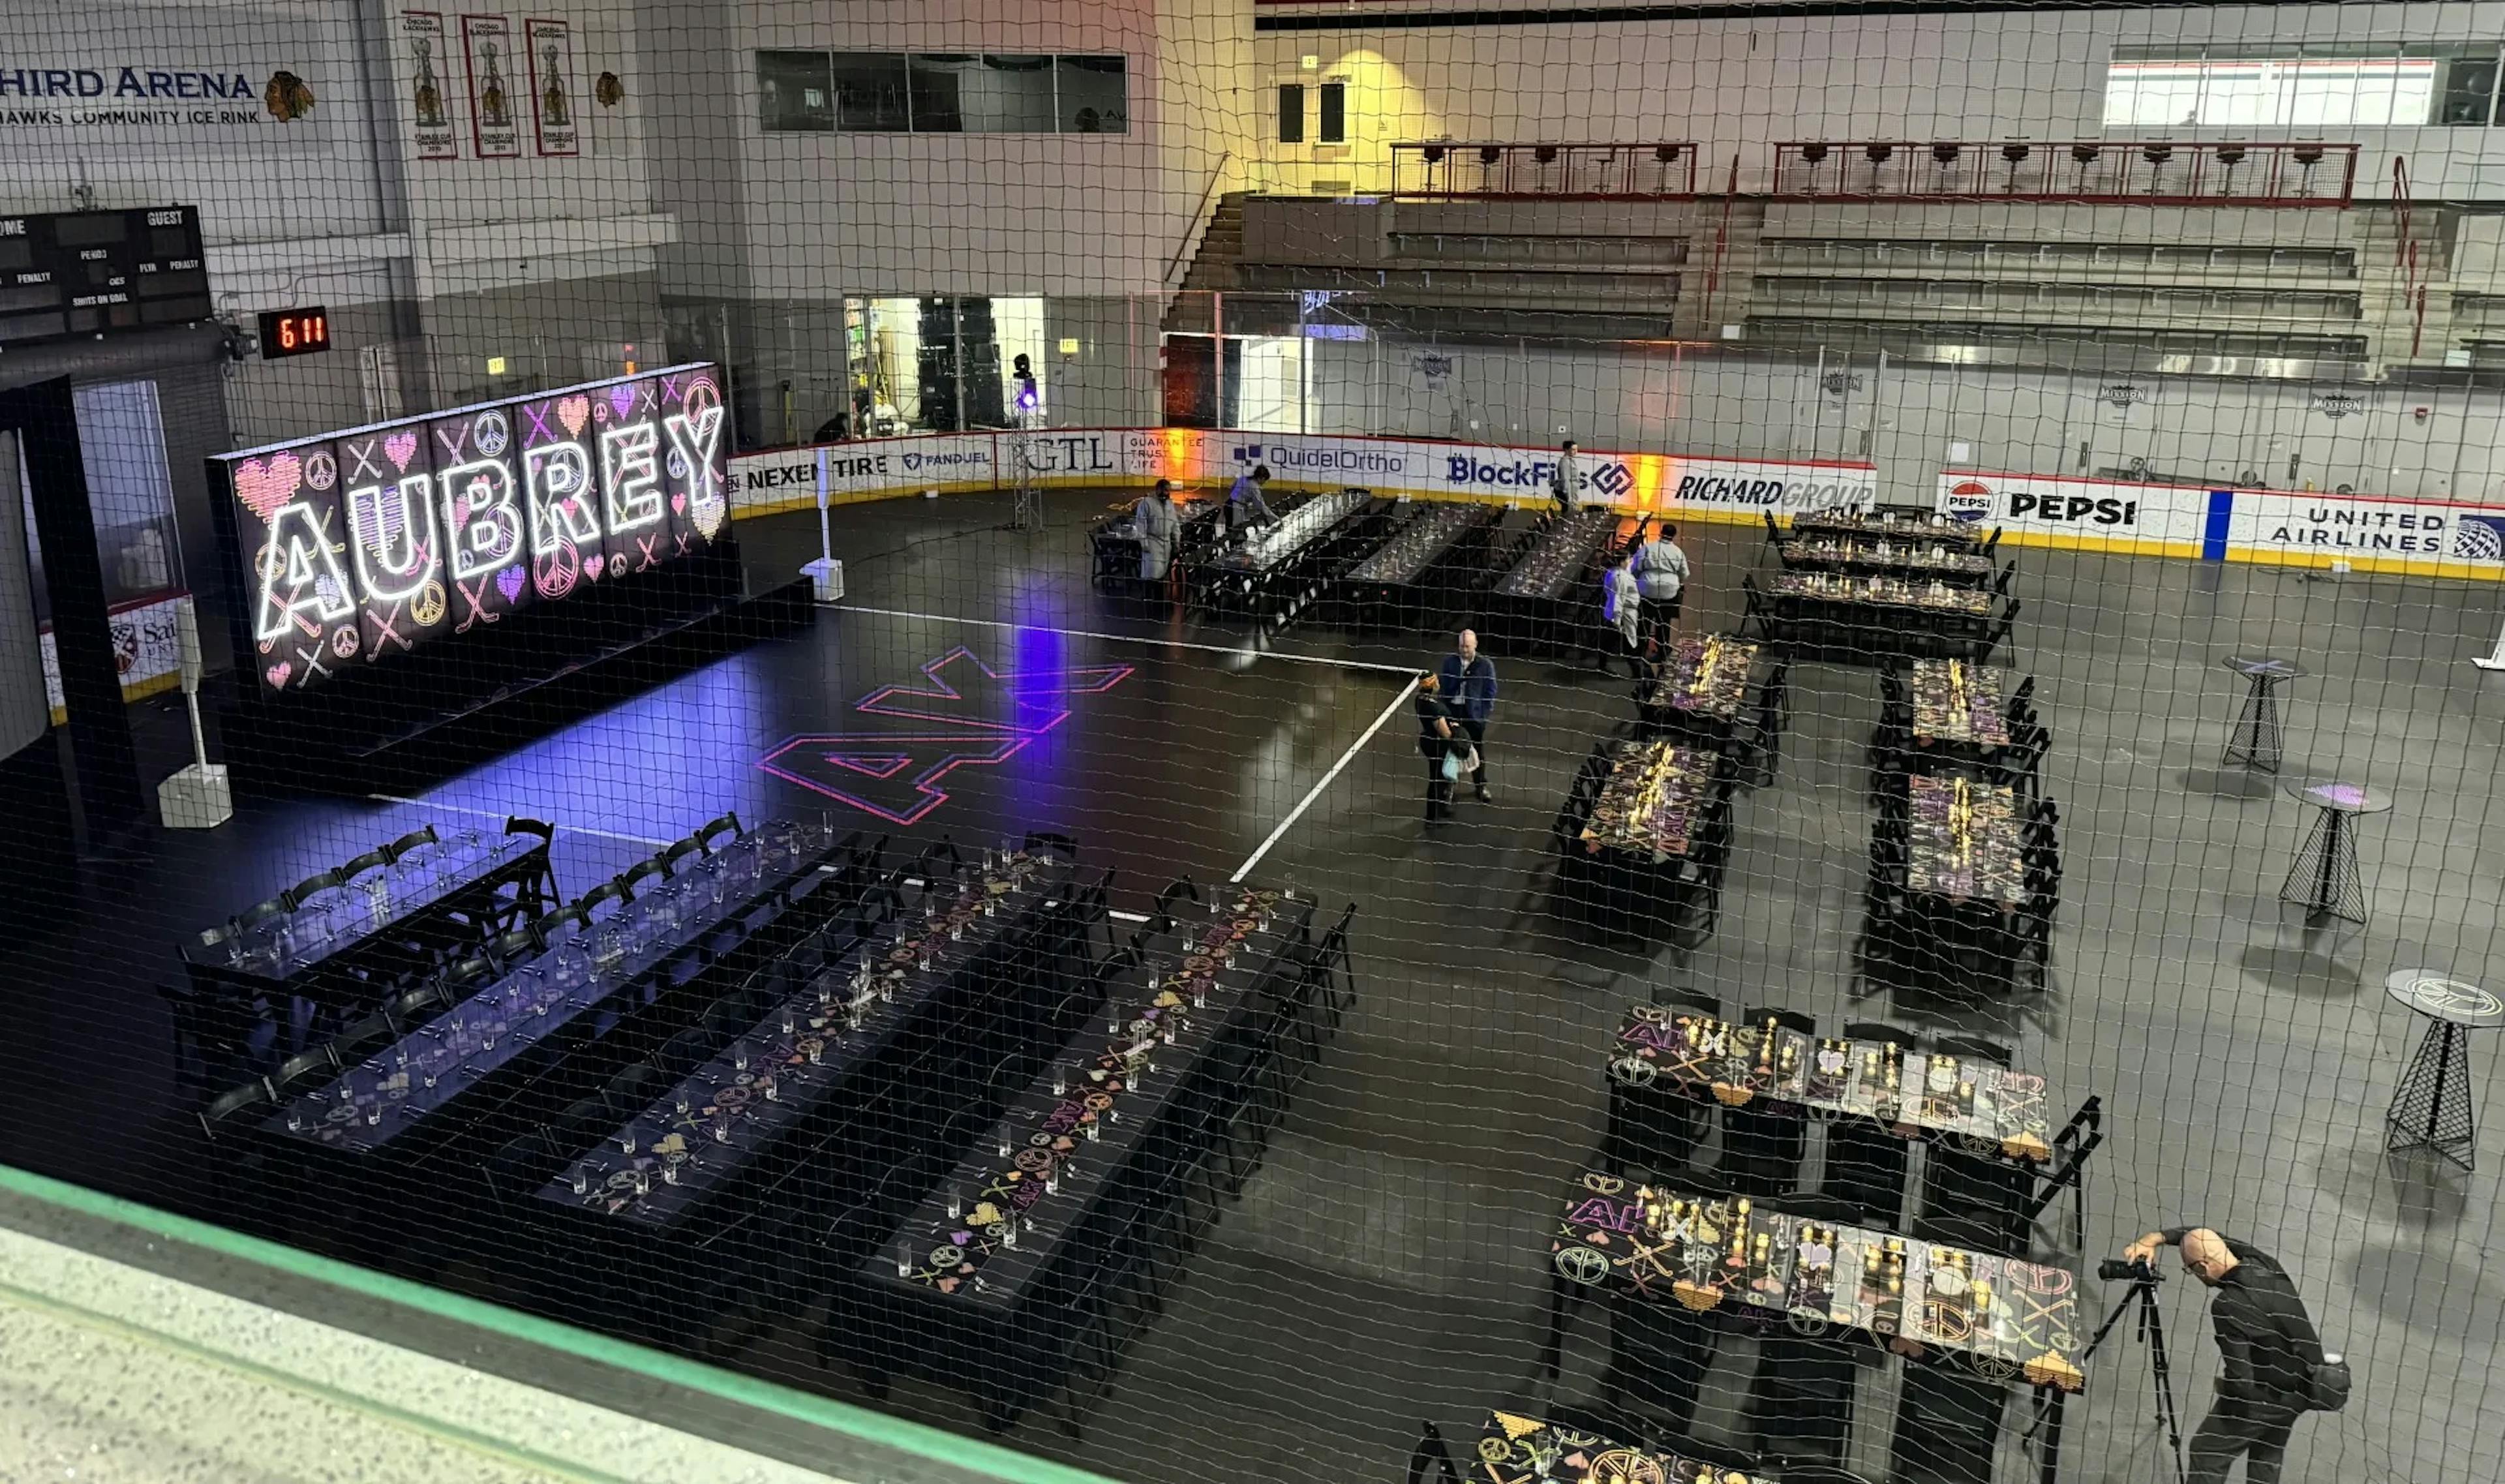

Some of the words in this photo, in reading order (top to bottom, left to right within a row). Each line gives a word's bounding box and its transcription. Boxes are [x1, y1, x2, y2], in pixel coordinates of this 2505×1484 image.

[114, 67, 256, 98] ARENA
[71, 111, 179, 124] COMMUNITY
[187, 111, 215, 123] ICE
[221, 111, 259, 123] RINK
[147, 210, 183, 226] GUEST
[832, 456, 888, 477] TIRE
[926, 452, 990, 466] FANDUEL
[1270, 447, 1403, 472] QuidelOrtho
[1446, 453, 1588, 490] BlockFis
[1949, 496, 1990, 508] PEPSI
[2009, 493, 2136, 525] PEPSI
[258, 406, 724, 641] AUBREY
[2309, 508, 2444, 530] UNITED
[2270, 526, 2441, 553] AIRLINES
